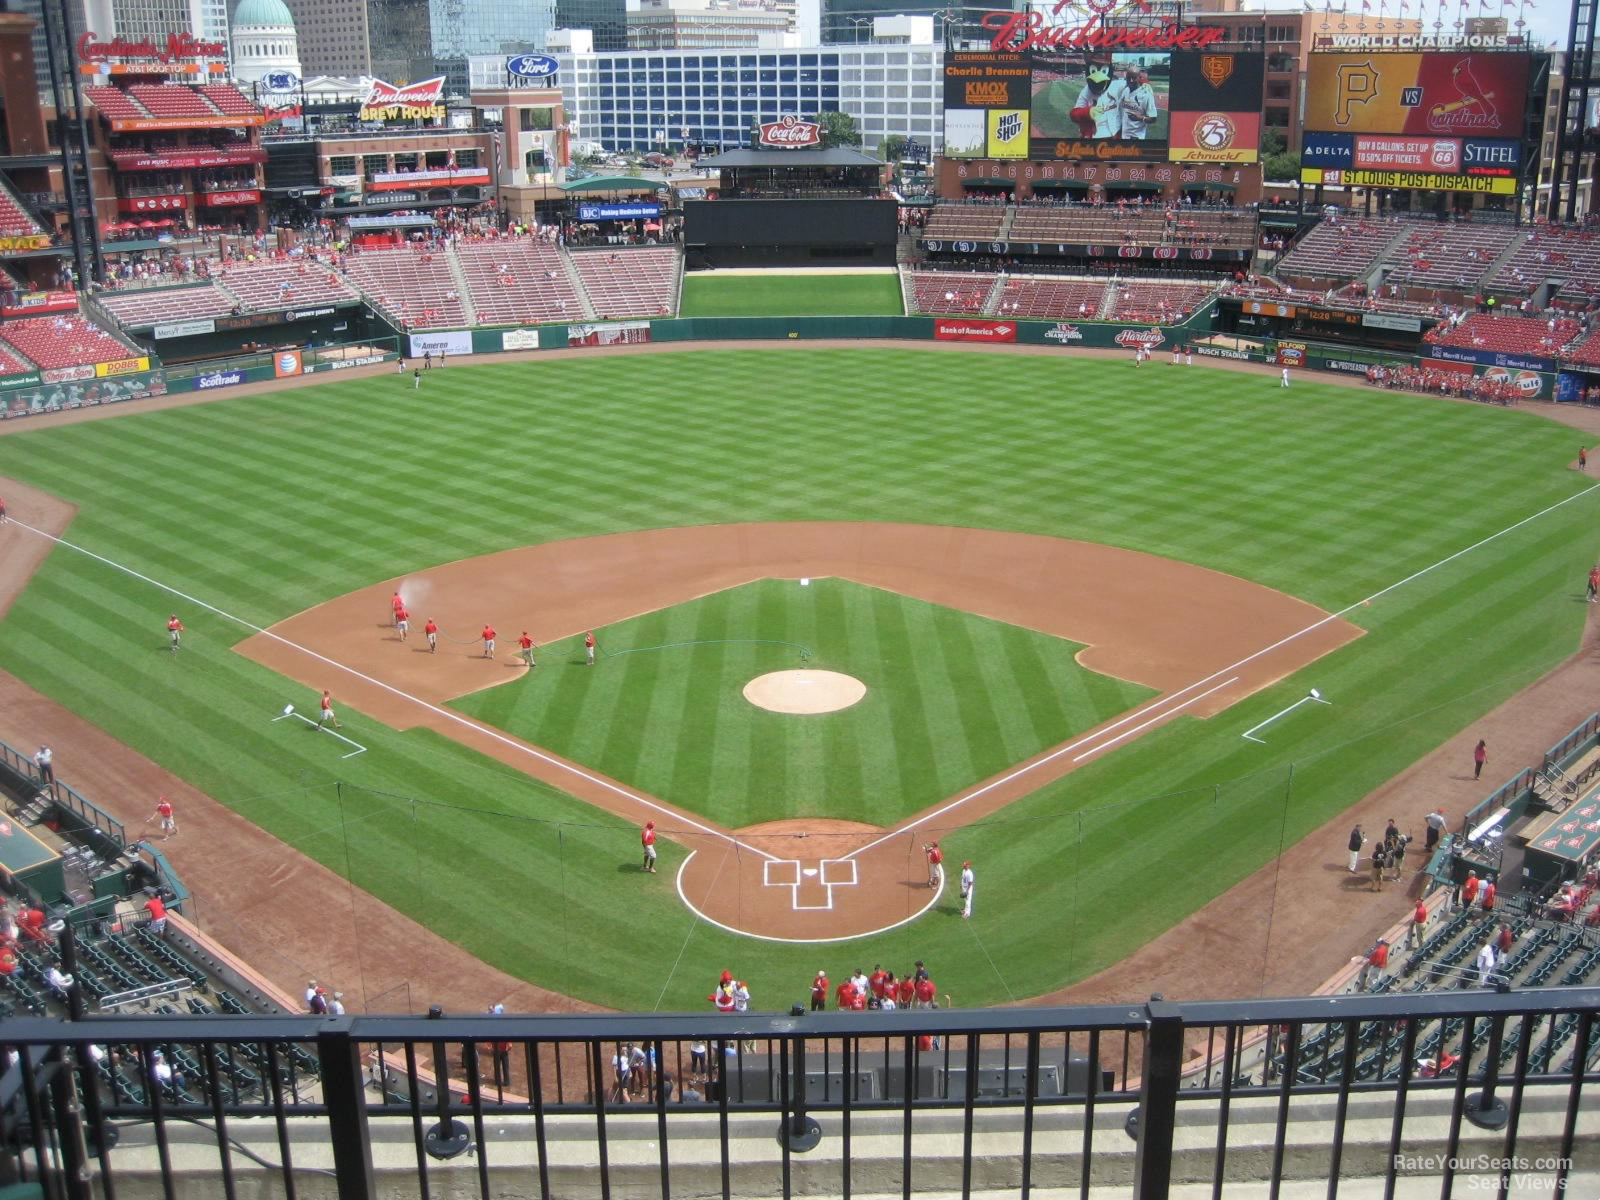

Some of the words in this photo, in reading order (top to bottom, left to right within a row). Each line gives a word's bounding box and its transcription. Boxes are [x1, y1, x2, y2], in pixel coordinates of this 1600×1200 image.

[981, 11, 1225, 50] Budweiser
[78, 32, 158, 62] Cardinals
[158, 32, 225, 62] Nation
[1331, 35, 1393, 47] WORLD
[1398, 35, 1508, 48] CHAMPIONS
[126, 65, 144, 73] AT&T
[146, 64, 186, 73] ROOFTOP
[519, 57, 551, 74] Ford
[946, 66, 983, 76] Charlie
[985, 66, 1029, 76] Brennan
[965, 82, 1008, 95] KMOX
[1334, 60, 1380, 126] P
[259, 94, 302, 106] MIDWEST
[364, 87, 443, 104] Budweiser
[360, 107, 399, 121] BREW
[401, 105, 447, 120] HOUSE
[999, 112, 1019, 127] HOT
[997, 122, 1022, 141] SHOT
[1201, 122, 1229, 145] 75
[1315, 147, 1350, 155] DELTA
[1358, 141, 1371, 150] BUY
[1407, 144, 1419, 152] GET
[1420, 144, 1429, 152] UP
[1464, 143, 1516, 162] STIFEL
[1183, 151, 1244, 160] Schnucks
[1366, 153, 1381, 162] 50%
[1382, 154, 1394, 163] OFF
[1435, 152, 1452, 162] 66
[978, 166, 984, 177] 1
[991, 166, 1000, 177] 2
[1025, 166, 1033, 178] 9
[1042, 167, 1054, 178] 10
[1062, 167, 1075, 179] 14
[1084, 168, 1097, 180] 17
[1105, 168, 1121, 180] 20
[1130, 169, 1145, 181] 24
[1155, 169, 1171, 181] 42
[1180, 170, 1196, 182] 45
[1205, 170, 1221, 182] 85
[1344, 170, 1359, 183] ST.
[1362, 171, 1395, 185] LOUIS
[1400, 173, 1493, 190] POST-DISPATCH
[583, 208, 598, 218] BJC
[601, 208, 619, 217] Making
[1310, 311, 1330, 320] 12:20
[940, 326, 957, 334] Bank
[965, 327, 994, 336] America
[1044, 332, 1083, 340] CHAMPIONS
[1198, 347, 1219, 356] BUSCH
[1221, 350, 1249, 359] STADIUM
[1442, 351, 1460, 359] Merrill
[1460, 354, 1477, 362] Lynch
[107, 360, 139, 371] DOBBS
[332, 361, 355, 369] BUSCH
[355, 355, 384, 366] STADIUM
[1507, 359, 1526, 367] Merrill
[1526, 361, 1542, 370] Lynch
[200, 374, 240, 388] Scottrade
